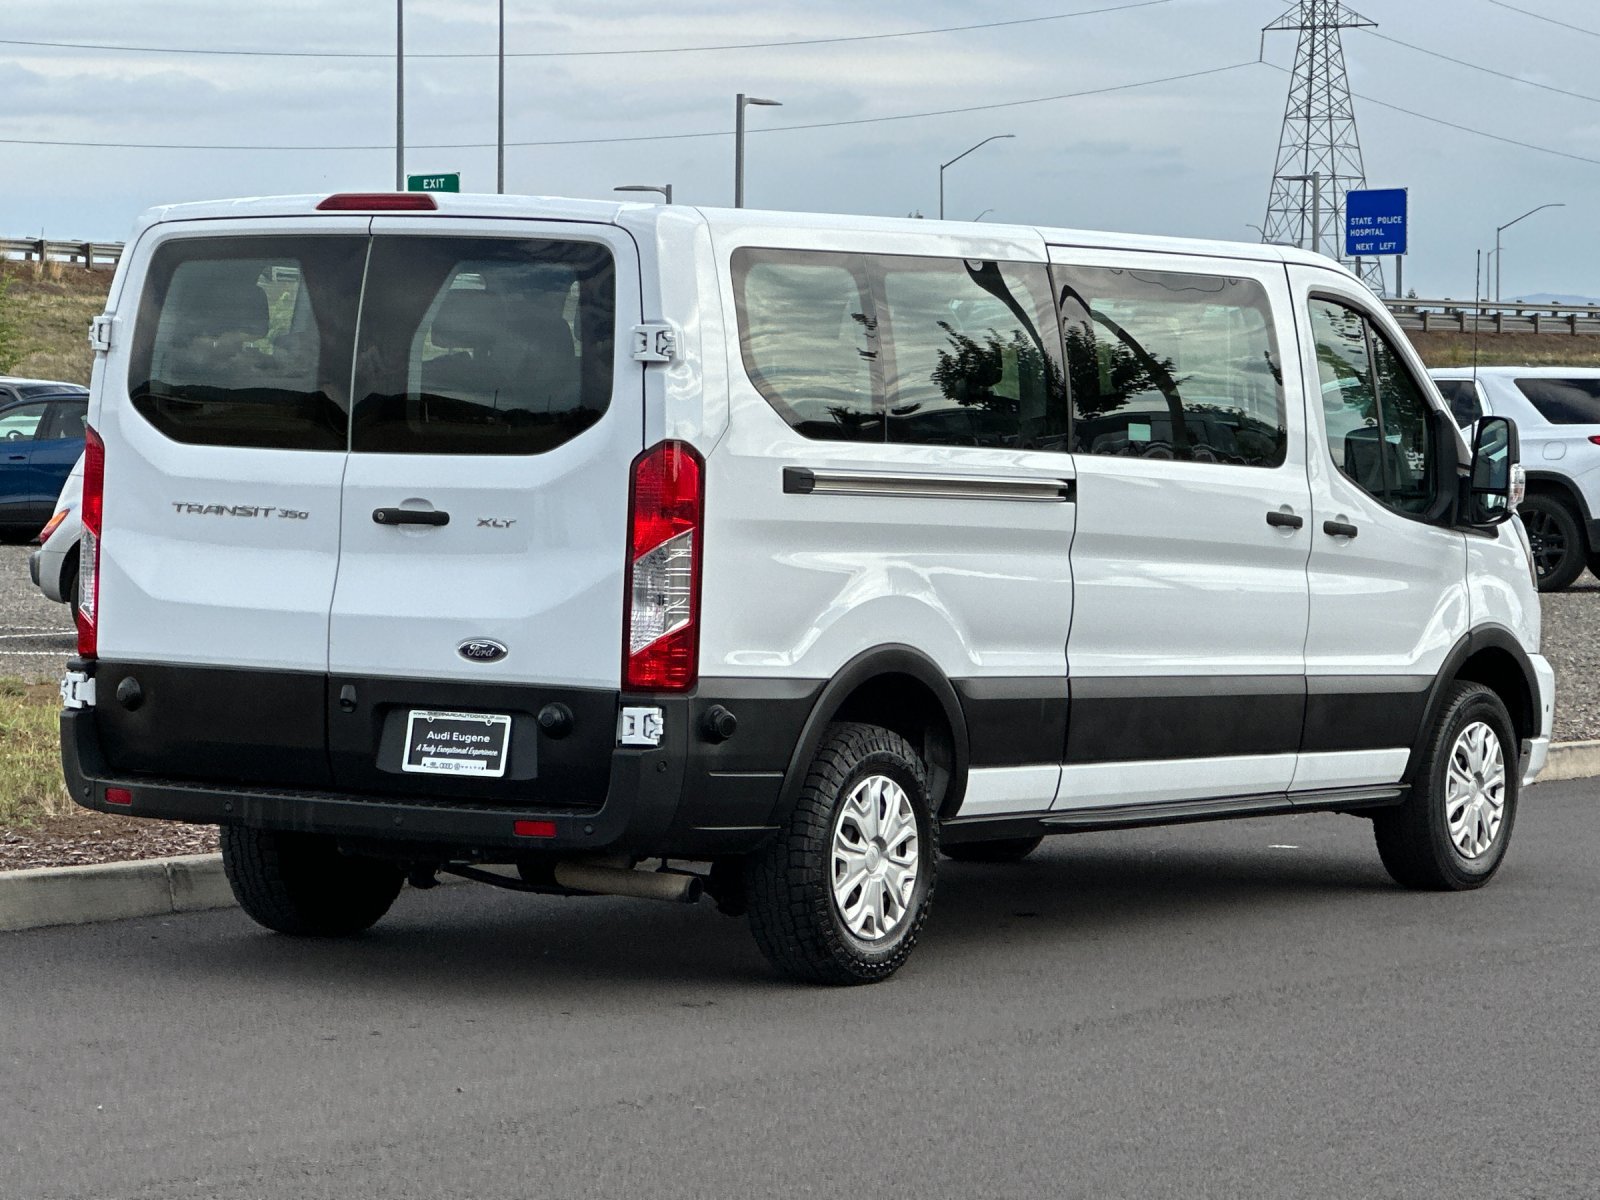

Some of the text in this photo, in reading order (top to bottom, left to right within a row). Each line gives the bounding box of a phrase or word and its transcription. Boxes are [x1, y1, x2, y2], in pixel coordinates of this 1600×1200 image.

[423, 178, 445, 189] EXIT
[1351, 216, 1402, 225] STATE POLICE
[1350, 228, 1384, 236] HOSPITAL
[1379, 242, 1396, 250] LEFT
[172, 502, 309, 520] TRANSIT 350
[477, 518, 517, 528] XLT
[467, 643, 495, 657] Ford
[426, 731, 491, 743] Audi Eugene
[422, 744, 436, 755] Truly
[436, 745, 469, 755] Exceptional
[468, 747, 498, 756] Experience
